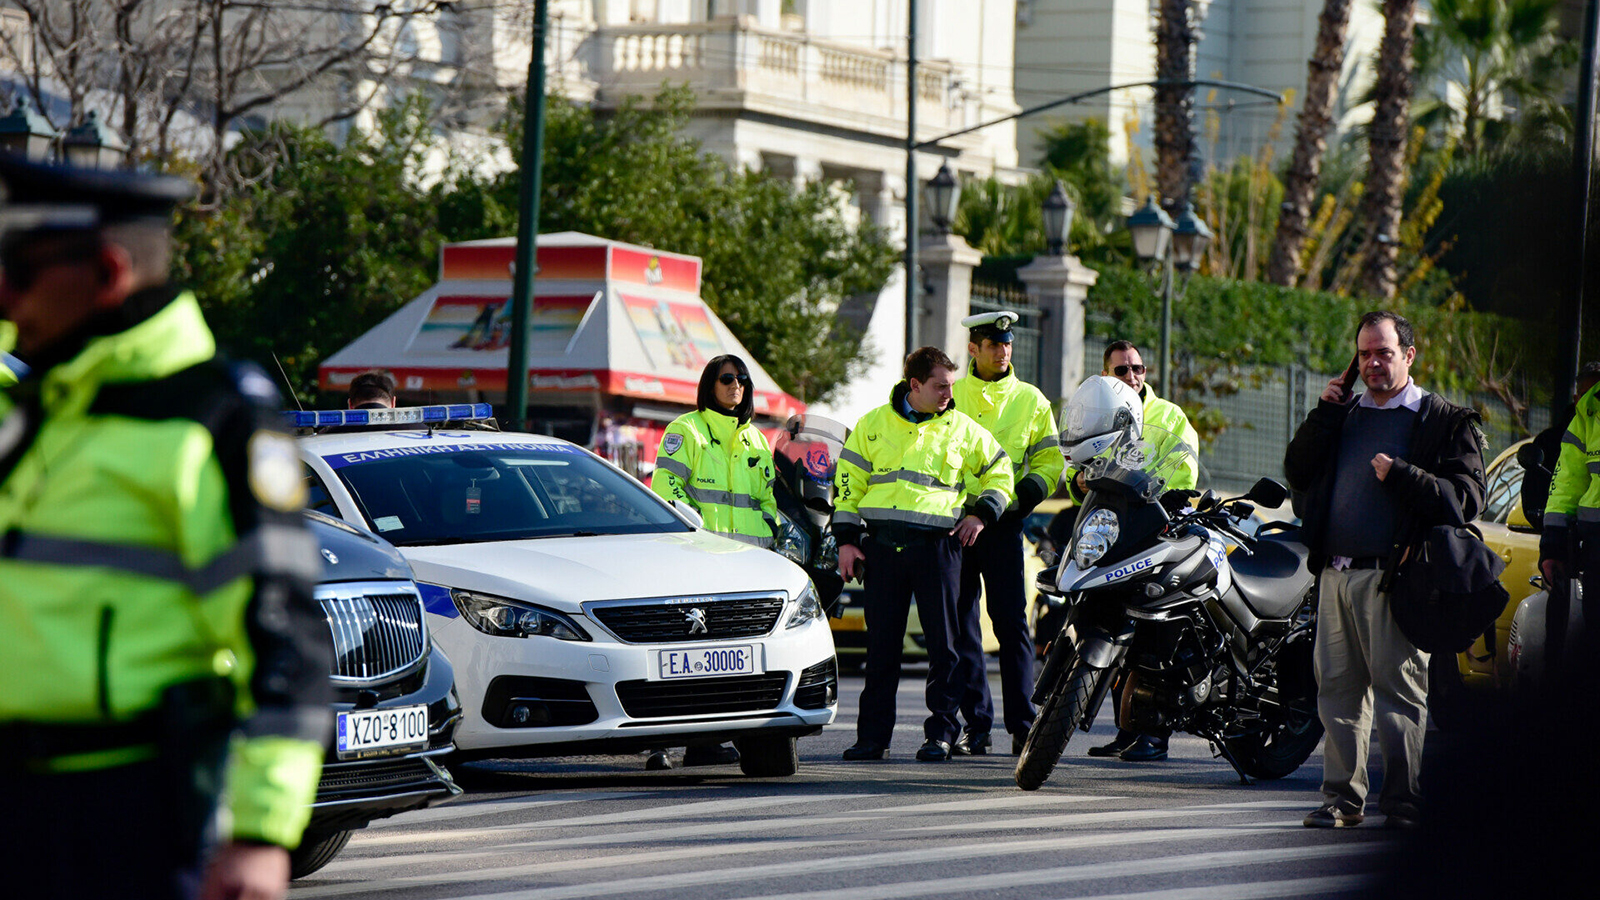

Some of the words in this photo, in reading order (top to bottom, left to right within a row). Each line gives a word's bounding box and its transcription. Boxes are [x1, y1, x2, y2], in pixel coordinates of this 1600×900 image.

[342, 444, 455, 463] ΕΛΛΗΝΙΚΗ
[841, 472, 851, 501] POLICE
[1105, 558, 1153, 581] POLICE
[704, 649, 745, 672] 30006
[352, 710, 425, 746] XZO-8100
